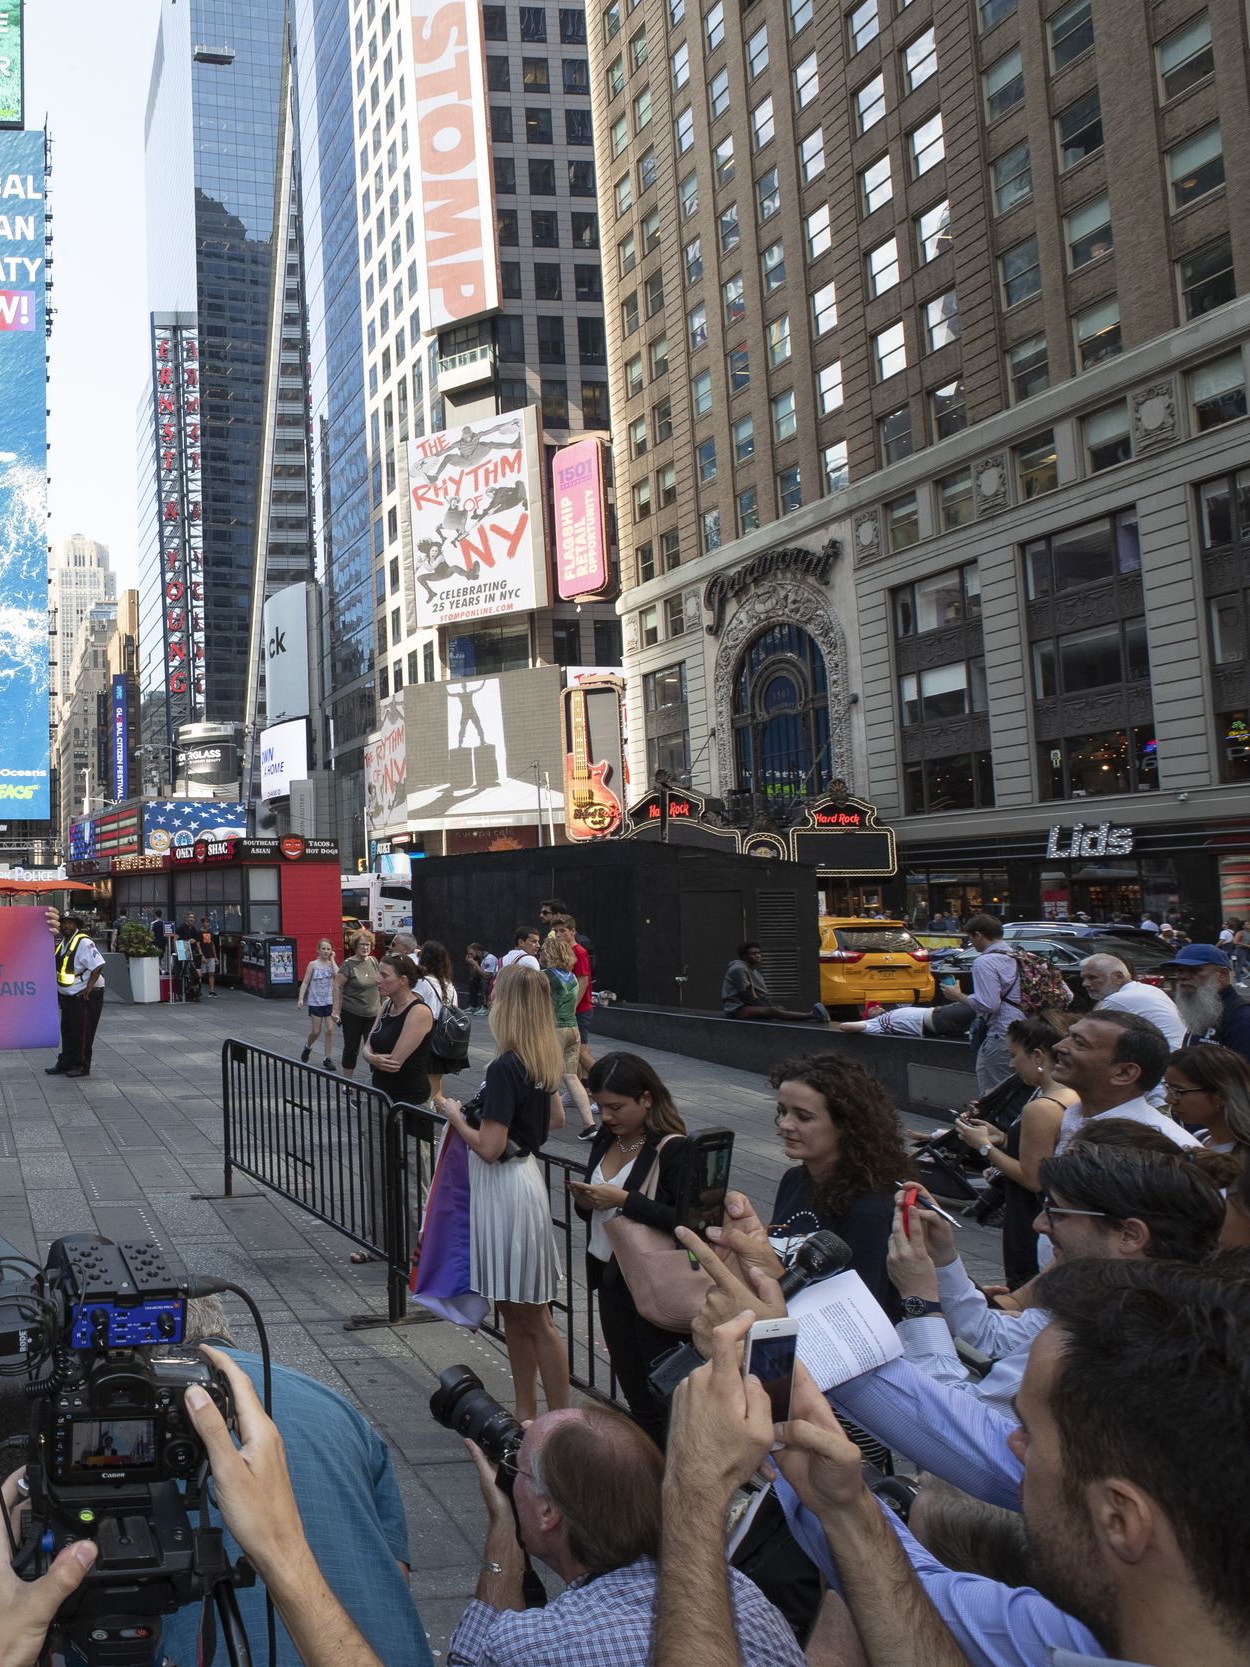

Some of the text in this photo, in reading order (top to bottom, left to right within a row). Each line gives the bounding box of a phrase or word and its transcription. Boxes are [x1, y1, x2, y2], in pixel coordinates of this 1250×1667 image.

[411, 2, 486, 321] STOMP
[158, 340, 175, 472] ERNST
[416, 434, 450, 458] THE
[412, 450, 522, 511] RHYTHM
[557, 458, 592, 484] 1501
[463, 495, 484, 513] OF
[458, 512, 528, 570] NY
[561, 496, 576, 582] FLAGSHIP
[585, 489, 598, 574] OPPORTUNITY
[574, 517, 589, 578] RETAIL
[439, 580, 507, 601] CELEBRATING
[704, 538, 841, 636] Paramount
[432, 588, 521, 613] 25 YEARS IN NYC
[440, 602, 514, 623] STOMPONLINE.COM
[166, 551, 187, 694] YOUNG
[267, 761, 284, 775] HOME
[116, 765, 124, 801] FESTIVAL
[649, 802, 689, 818] Ha Rock
[816, 812, 861, 826] Hard Rock
[171, 847, 194, 860] CONEY
[207, 841, 235, 856] SHACK
[377, 842, 391, 854] AT&T
[1047, 821, 1134, 860] Lids
[14, 866, 53, 881] POLICE
